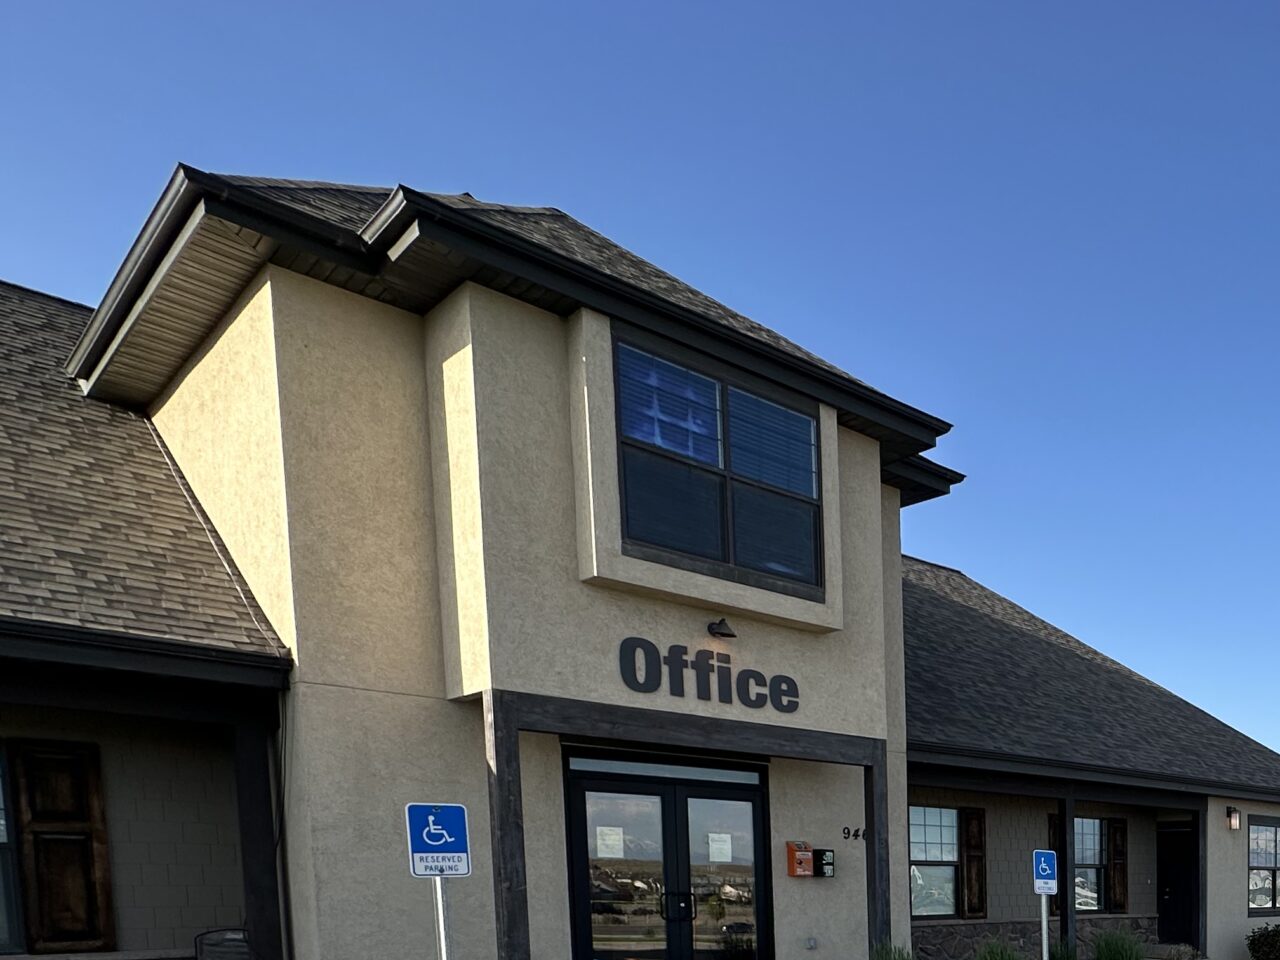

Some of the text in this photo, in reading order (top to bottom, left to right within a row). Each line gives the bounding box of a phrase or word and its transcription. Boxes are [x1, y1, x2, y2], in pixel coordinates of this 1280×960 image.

[619, 636, 800, 713] Office
[419, 855, 463, 863] RESERVED
[424, 864, 459, 872] PARKING
